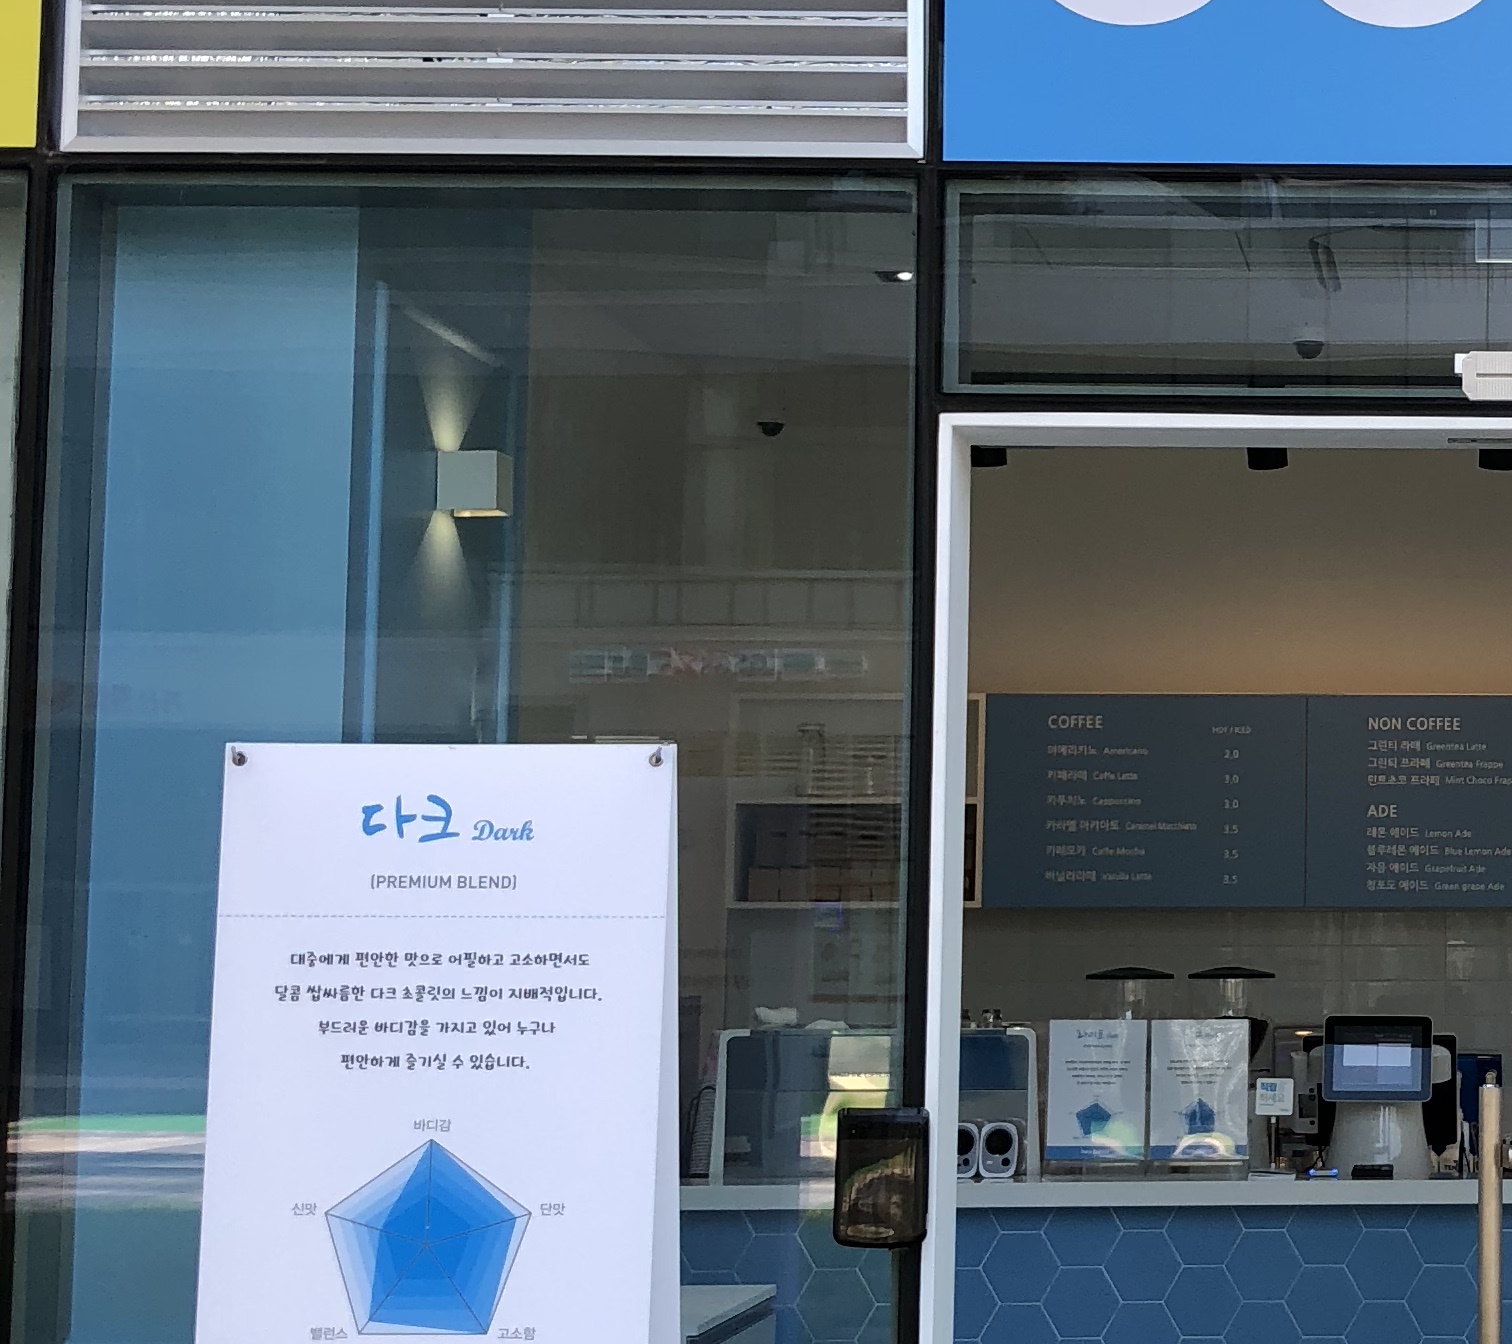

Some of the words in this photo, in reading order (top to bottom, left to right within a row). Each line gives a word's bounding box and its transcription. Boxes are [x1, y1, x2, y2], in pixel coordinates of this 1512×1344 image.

[1047, 715, 1104, 729] COFFEE
[1368, 717, 1402, 731] NON
[1406, 717, 1461, 731] COFFEE
[1425, 742, 1465, 752] Greentea
[1466, 742, 1487, 752] Latte
[1223, 749, 1240, 760] 2.0
[1435, 759, 1473, 769] Greentea
[1475, 759, 1504, 771] Frappe
[1223, 774, 1240, 785] 3.0
[1445, 776, 1465, 786] Mint
[1466, 776, 1493, 786] Choco
[1366, 804, 1398, 818] ADE
[361, 794, 461, 844] 다크
[471, 819, 535, 842] Dark
[1389, 826, 1420, 839] 에이드
[1425, 829, 1453, 839] Lemon
[1454, 829, 1472, 839] Ade
[1409, 844, 1439, 857] 에이드
[1444, 846, 1463, 856] Blue
[1464, 846, 1493, 856] Lemon
[1494, 846, 1512, 856] Ade
[1389, 861, 1420, 874] 에이드
[1424, 864, 1467, 875] Grapefruit
[1468, 864, 1487, 874] Ade
[1398, 879, 1430, 892] 에이드
[1434, 882, 1460, 892] Green
[1461, 883, 1486, 893] grape
[1487, 882, 1505, 892] Ade
[290, 951, 350, 968] 대중에게
[354, 951, 399, 968] 편안한
[404, 951, 443, 968] 맛으로
[448, 951, 504, 969] 어필하고
[509, 952, 590, 969] 고소하면서도
[274, 984, 301, 1002] 달콤
[370, 987, 397, 1000] 다크
[402, 984, 456, 1003] 초콜릿의
[460, 985, 503, 1003] 느낌이
[508, 985, 603, 1003] 지배적입니다.
[318, 1019, 370, 1036] 부드러운
[374, 1019, 431, 1037] 바디감을
[435, 1021, 477, 1034] 가지고
[482, 1019, 512, 1037] 있어
[516, 1020, 557, 1036] 누구나
[340, 1053, 401, 1071] 편안하게
[405, 1052, 447, 1071] 즐기실
[452, 1054, 464, 1070] 수
[469, 1052, 530, 1071] 있습니다.
[412, 1118, 452, 1133] 바디감
[291, 1202, 318, 1217] 신맛
[539, 1202, 566, 1217] 단맛
[309, 1326, 349, 1341] 밸런스
[497, 1326, 537, 1342] 고소함
